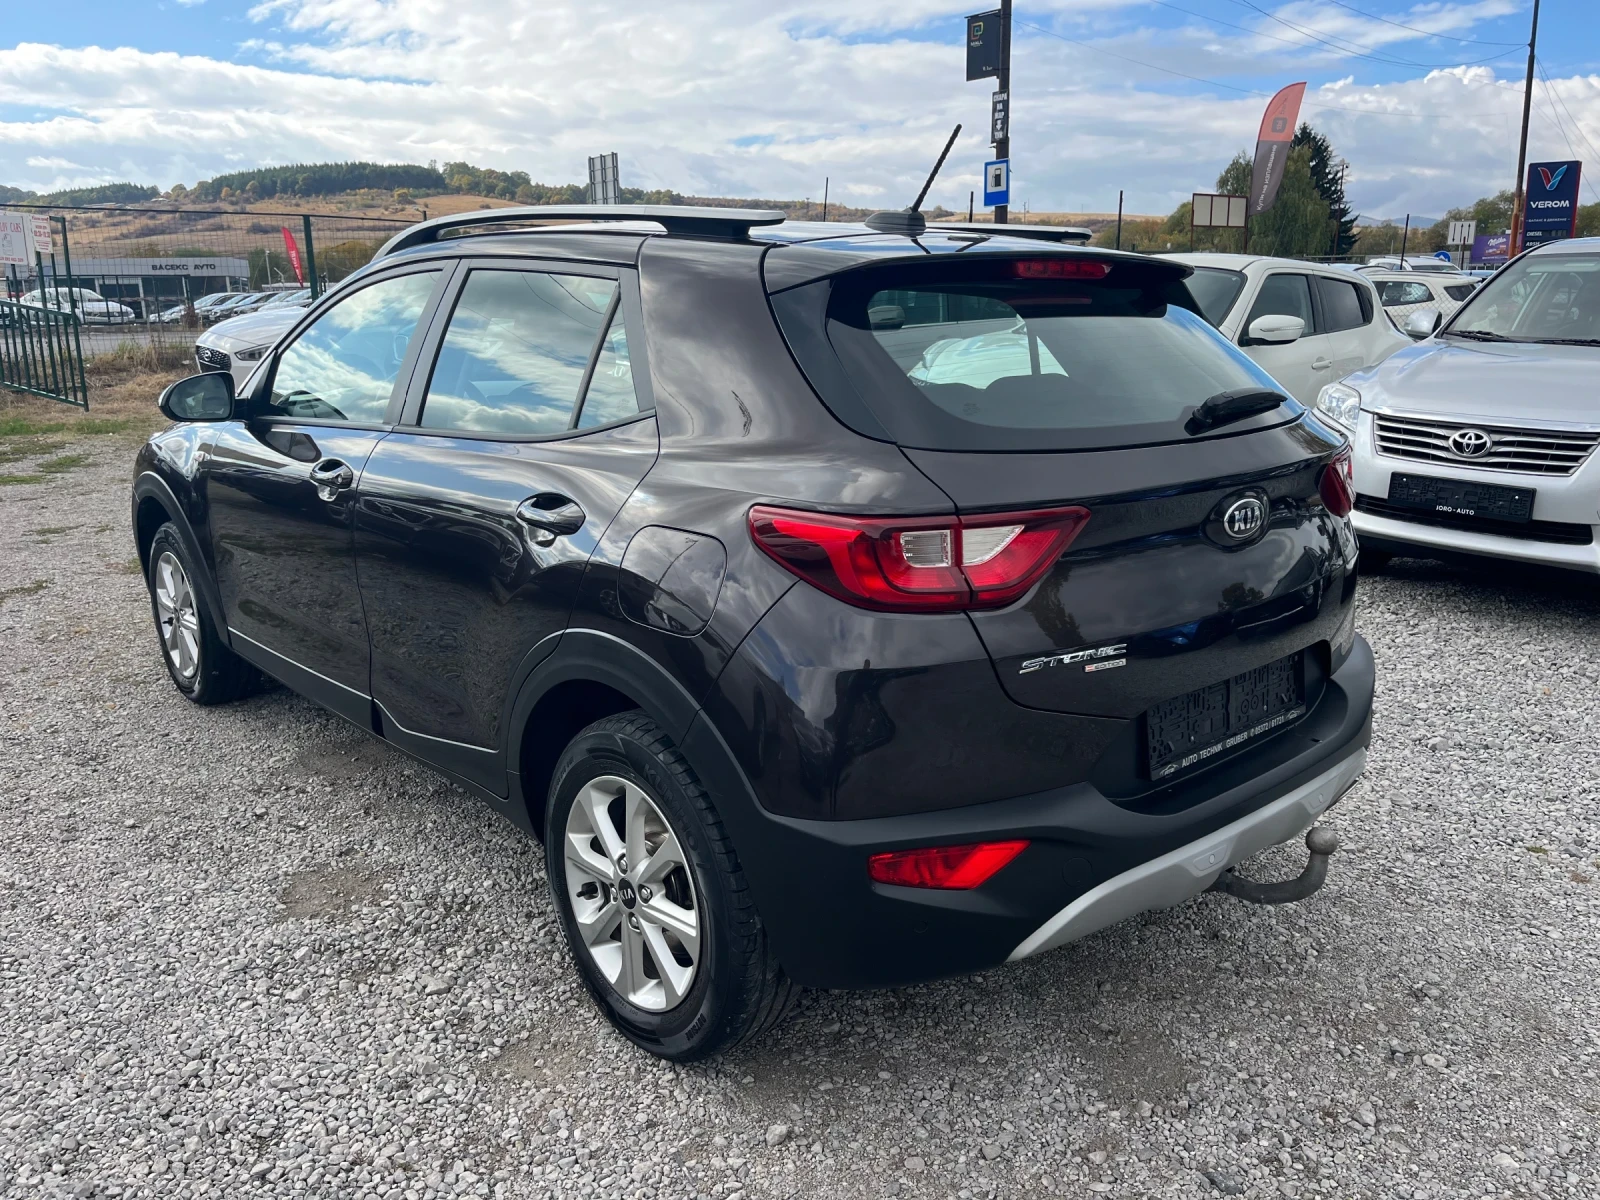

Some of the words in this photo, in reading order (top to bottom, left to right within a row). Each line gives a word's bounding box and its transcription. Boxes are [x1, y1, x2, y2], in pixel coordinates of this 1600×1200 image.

[1256, 194, 1265, 211] Купи
[1262, 184, 1268, 193] на
[1530, 200, 1570, 208] VEROM
[1487, 236, 1507, 247] Milka
[1233, 506, 1261, 532] KIA
[1019, 643, 1128, 675] STONIC
[1181, 753, 1198, 768] AUTO
[1200, 742, 1223, 760] TECHNIK
[1225, 731, 1248, 748] GRUBER
